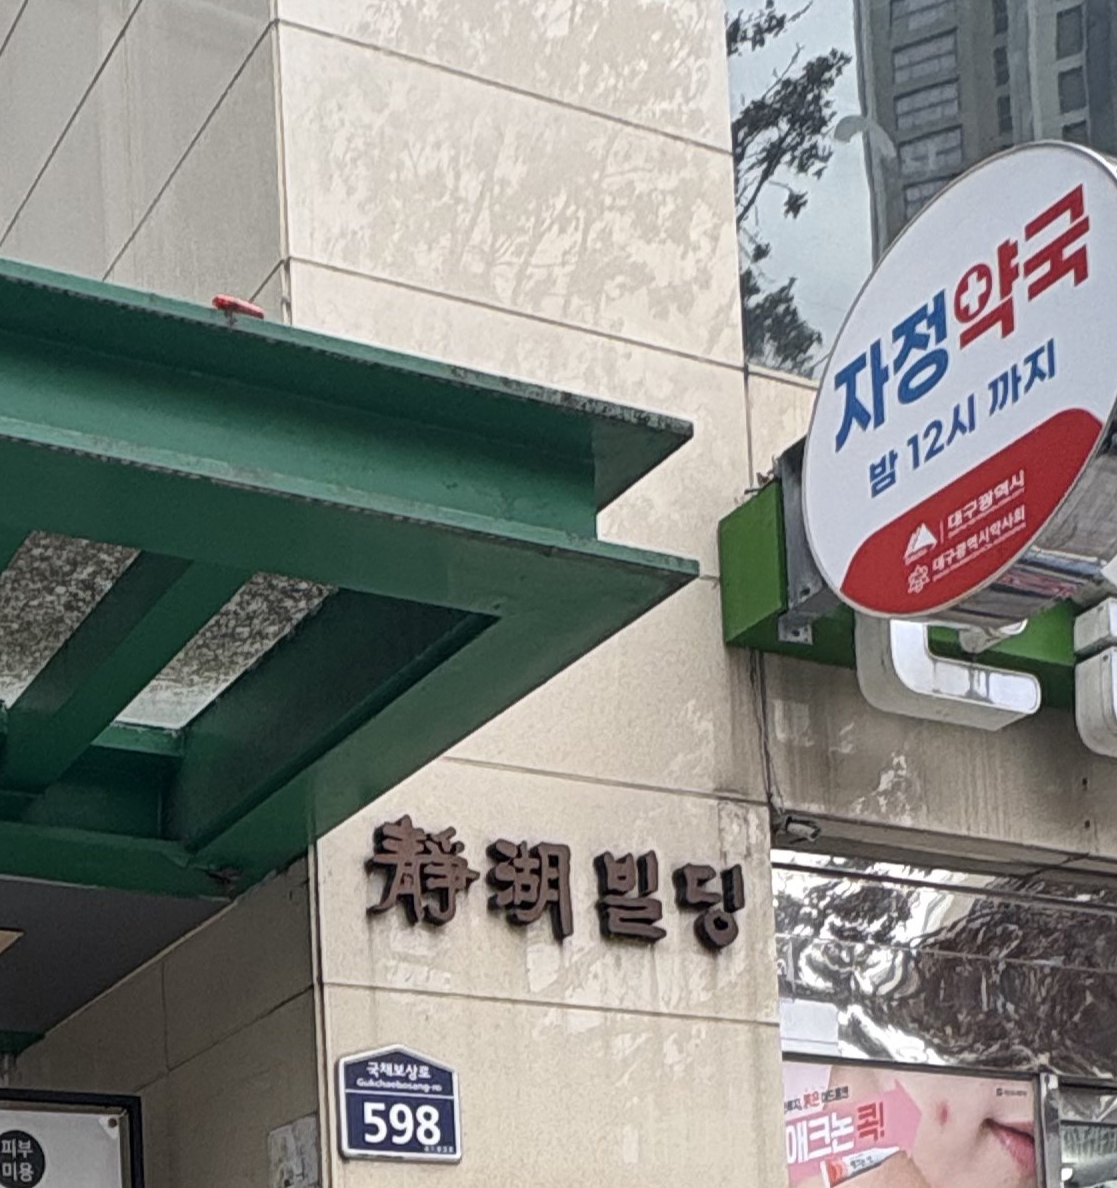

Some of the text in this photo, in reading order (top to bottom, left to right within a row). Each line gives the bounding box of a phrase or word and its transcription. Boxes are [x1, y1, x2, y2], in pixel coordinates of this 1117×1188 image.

[834, 183, 1091, 453] 자정약국
[868, 338, 1056, 498] 밤 12시 까지
[947, 470, 1024, 529] 대구광역시
[933, 504, 1025, 571] 대구광역시약사회
[356, 1078, 442, 1093] Gukchaebosang-ro
[366, 1062, 432, 1080] 국채보상로
[1, 1139, 33, 1158] 피부
[364, 1102, 441, 1145] 598
[786, 1101, 885, 1164] 애크논 콕!
[2, 1162, 33, 1183] 미용
